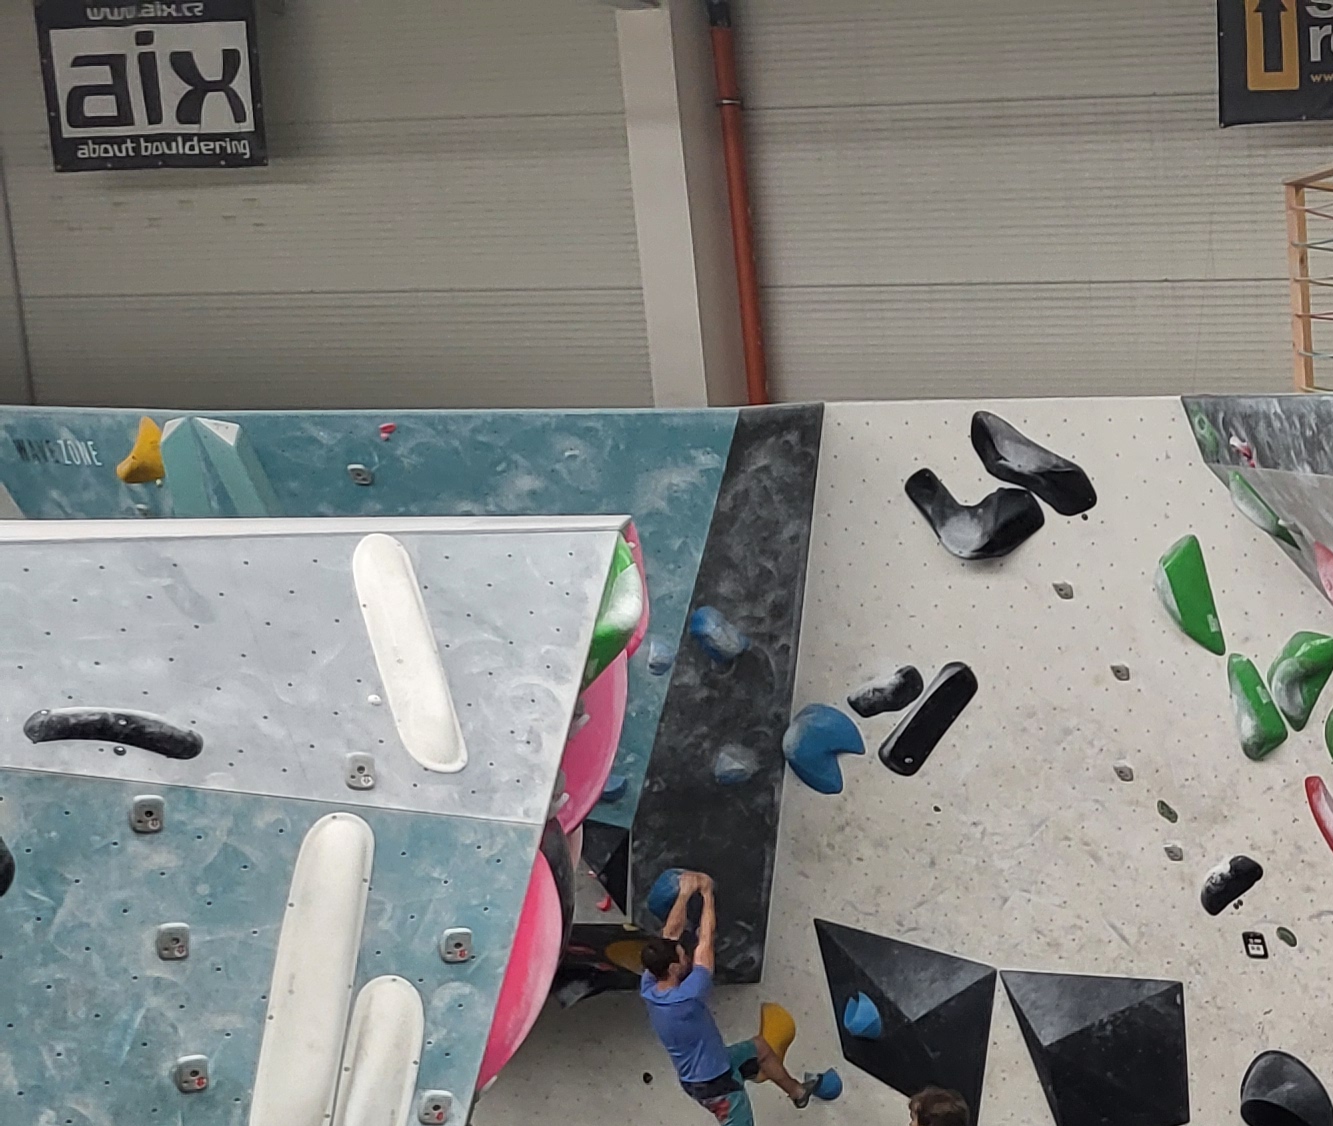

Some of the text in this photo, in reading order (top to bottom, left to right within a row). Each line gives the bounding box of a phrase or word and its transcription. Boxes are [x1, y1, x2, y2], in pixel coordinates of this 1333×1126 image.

[66, 30, 248, 129] aix
[77, 135, 250, 159] about bouldering
[56, 439, 103, 466] ZONE
